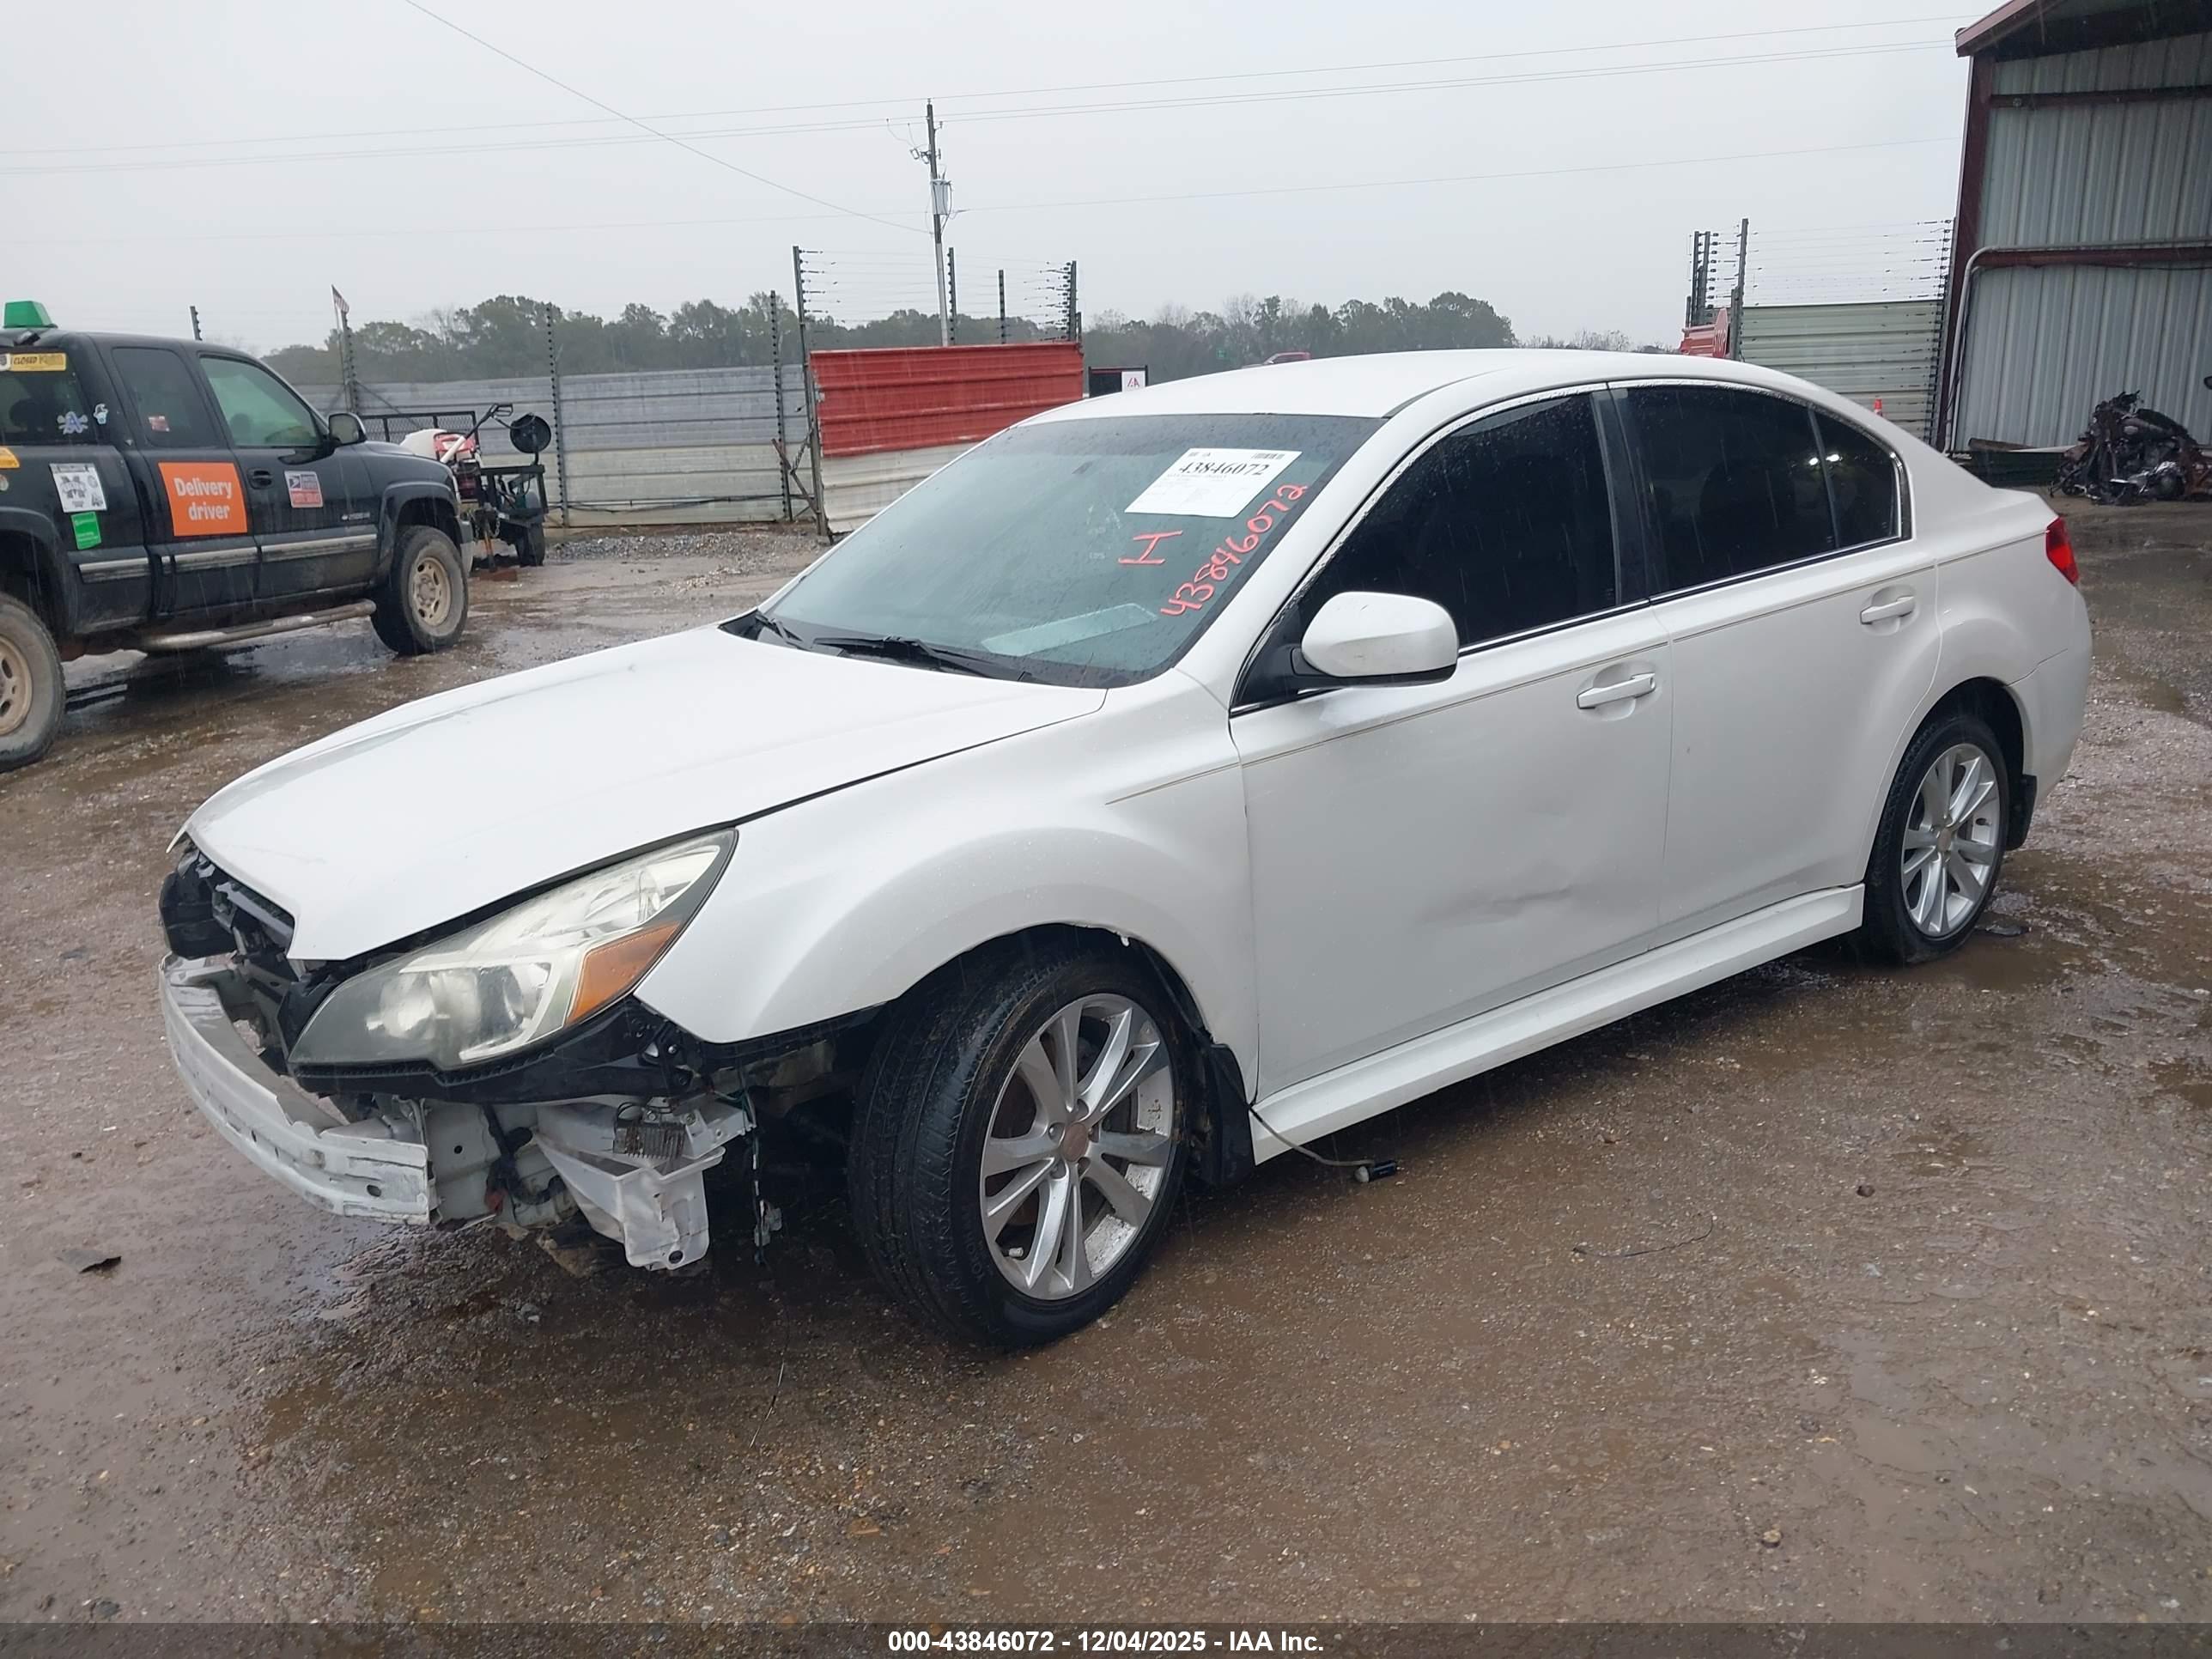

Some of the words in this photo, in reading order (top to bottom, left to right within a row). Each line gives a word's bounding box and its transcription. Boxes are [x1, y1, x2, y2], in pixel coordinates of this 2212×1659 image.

[1713, 329, 1726, 352] STOP
[1178, 462, 1270, 476] 43846072
[173, 477, 232, 500] Delivery
[188, 501, 230, 520] driver
[1160, 484, 1308, 616] 43846072
